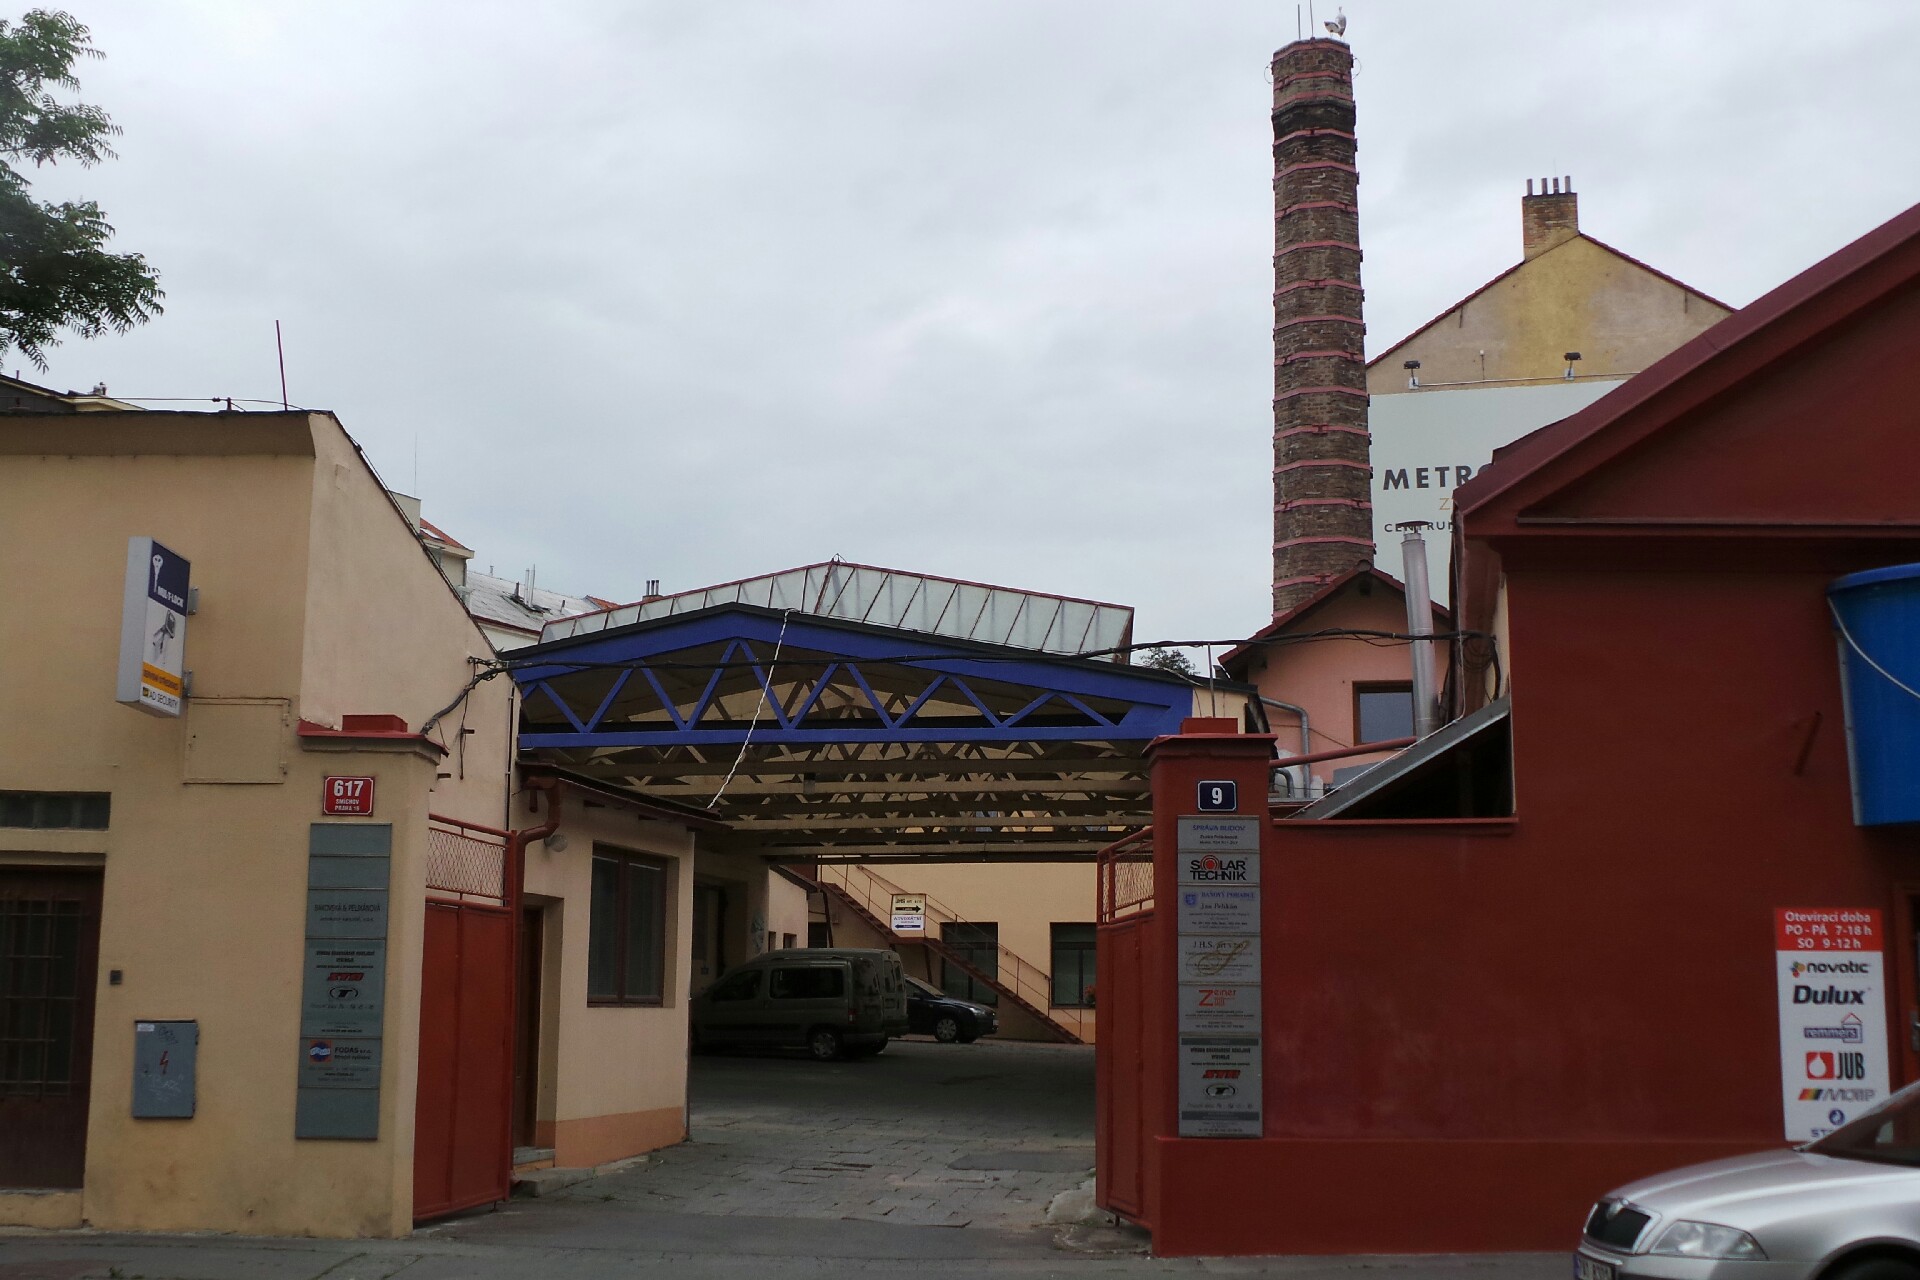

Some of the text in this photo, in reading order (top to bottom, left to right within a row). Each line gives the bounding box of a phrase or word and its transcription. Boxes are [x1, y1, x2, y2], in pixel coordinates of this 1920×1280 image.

[333, 780, 364, 797] 617
[1211, 787, 1223, 805] 9
[1190, 855, 1247, 870] SOLAR
[1190, 870, 1247, 881] TECHNIK
[1841, 912, 1871, 923] doba
[1785, 924, 1803, 935] PO
[1812, 923, 1828, 935] PÁ
[1798, 938, 1814, 949] SO
[1807, 961, 1871, 974] novatic
[1793, 985, 1865, 1005] Dulux
[1837, 1052, 1865, 1080] JUB
